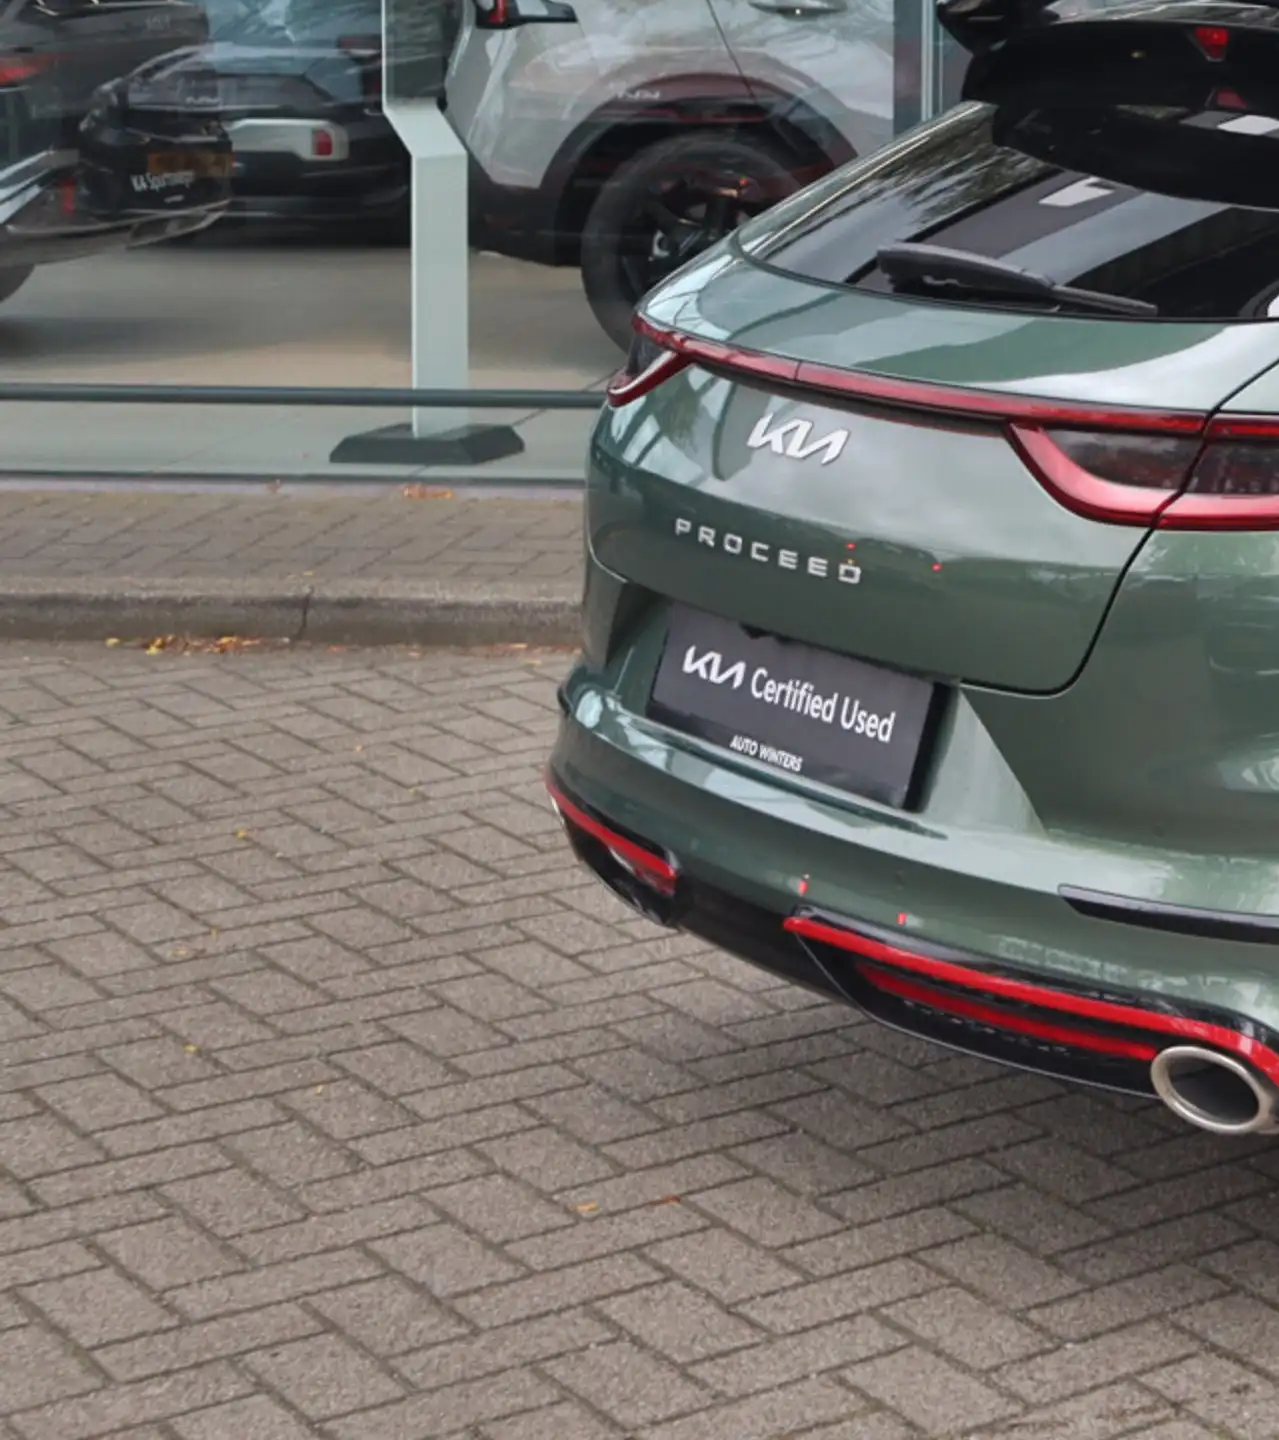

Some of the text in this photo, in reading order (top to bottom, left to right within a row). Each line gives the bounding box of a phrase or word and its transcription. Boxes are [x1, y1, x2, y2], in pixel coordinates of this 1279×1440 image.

[747, 413, 850, 465] KIA
[674, 517, 863, 585] PROCEED
[682, 644, 896, 743] KIA Certified Used
[729, 734, 802, 773] AUTO WINTERS
